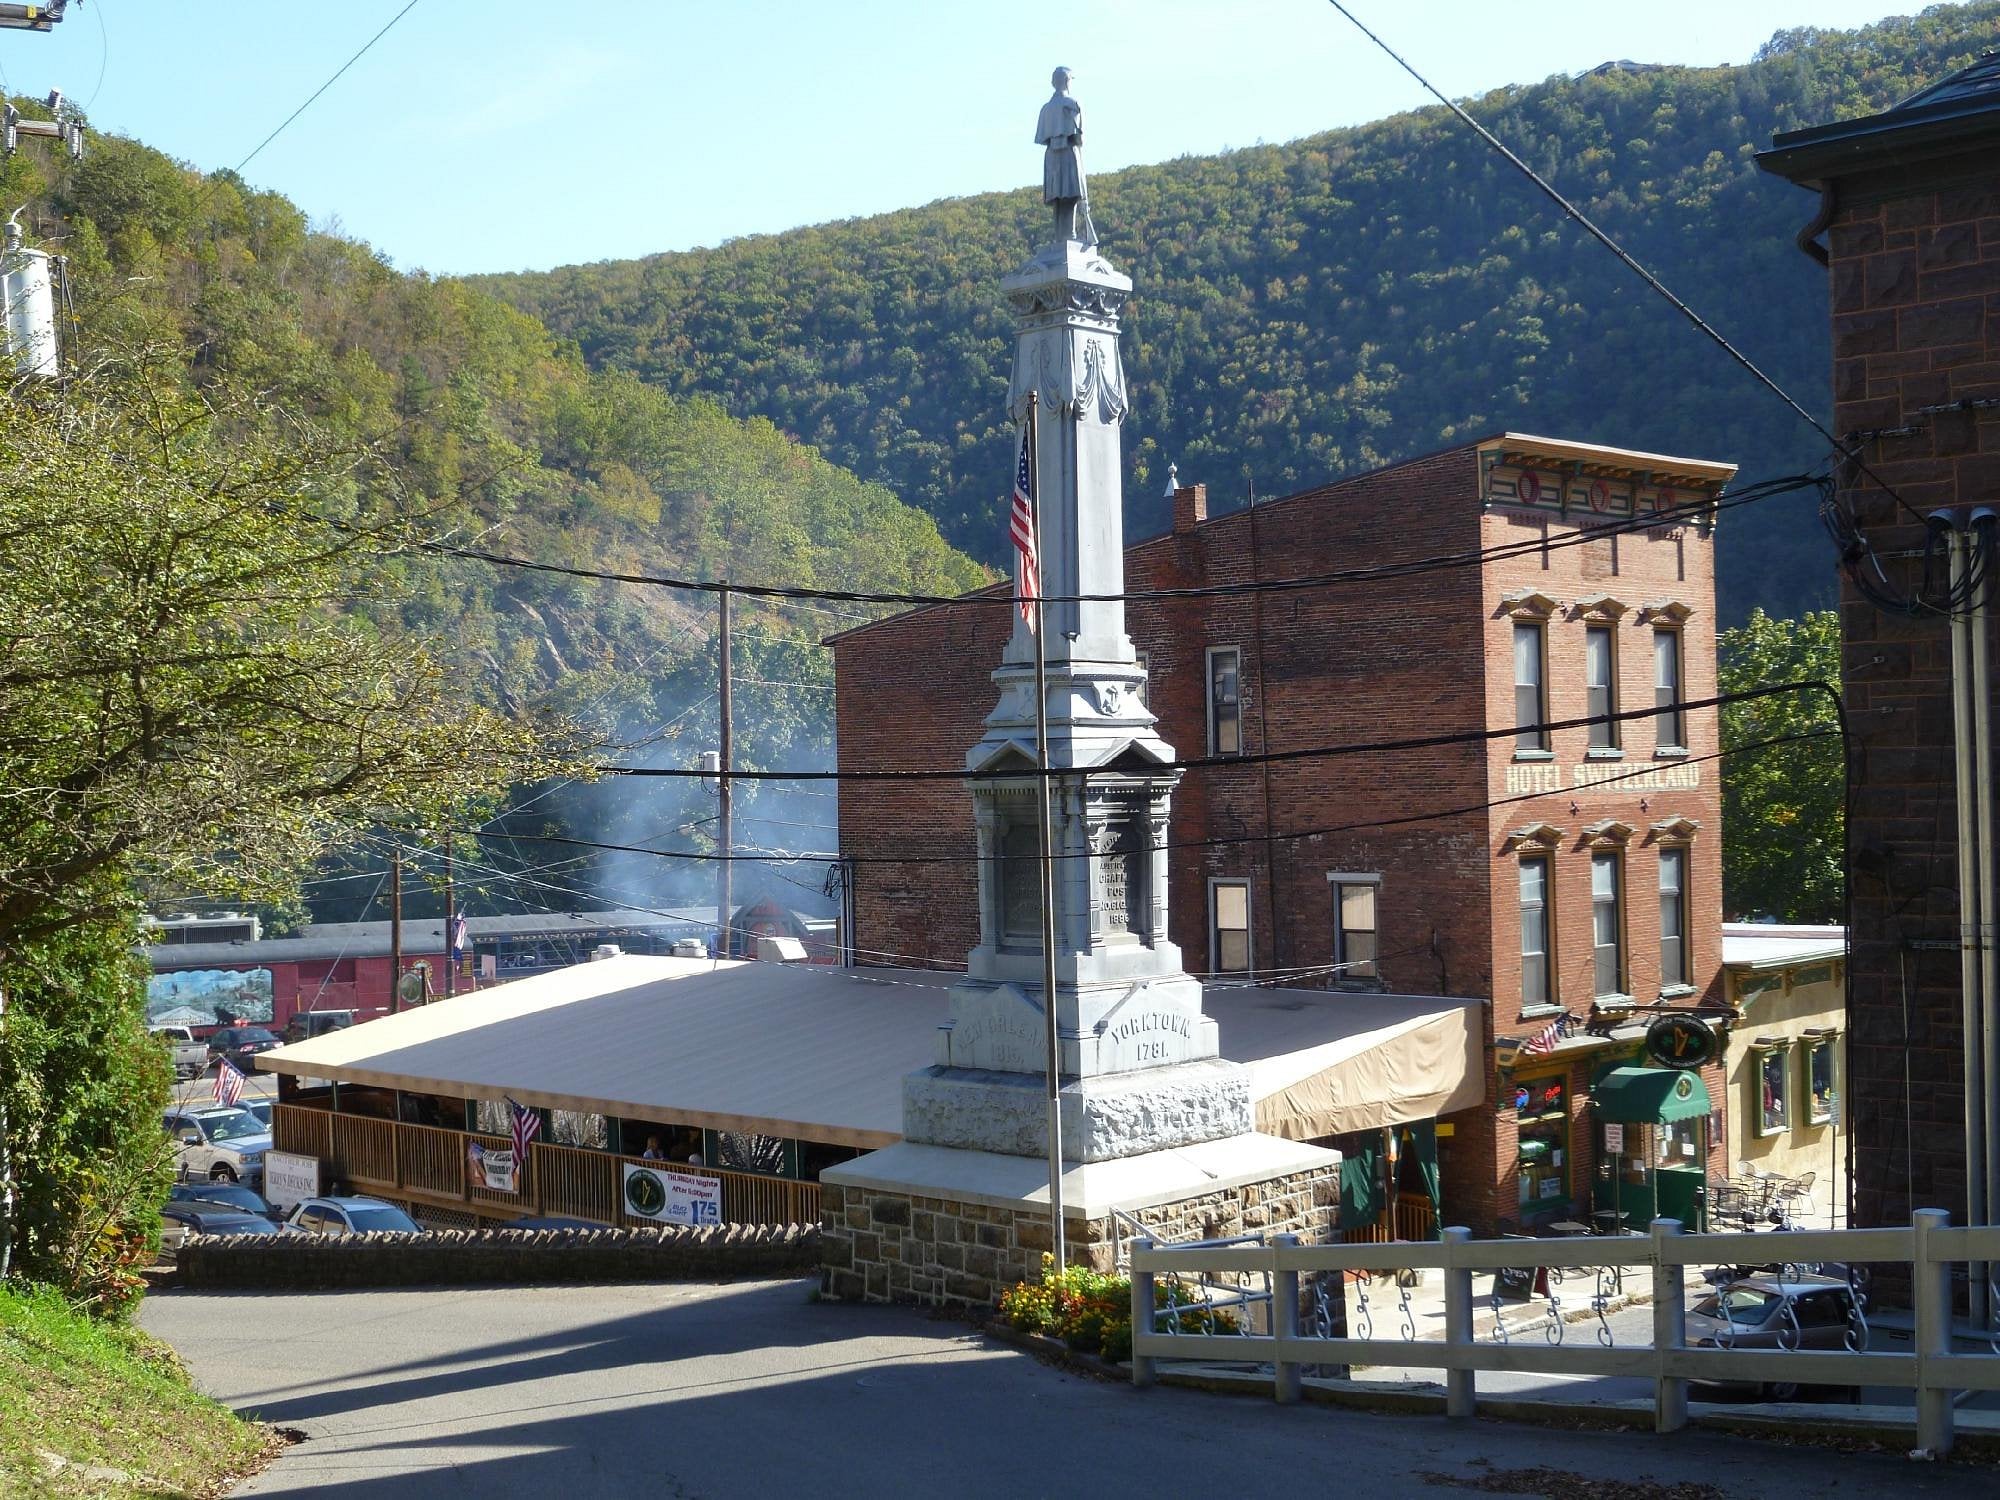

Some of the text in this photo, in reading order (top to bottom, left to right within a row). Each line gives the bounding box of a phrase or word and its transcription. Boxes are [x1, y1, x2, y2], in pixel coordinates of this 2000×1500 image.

[1505, 763, 1700, 794] HOTEL SWITZERLAND
[512, 931, 598, 942] MOUNTAIN
